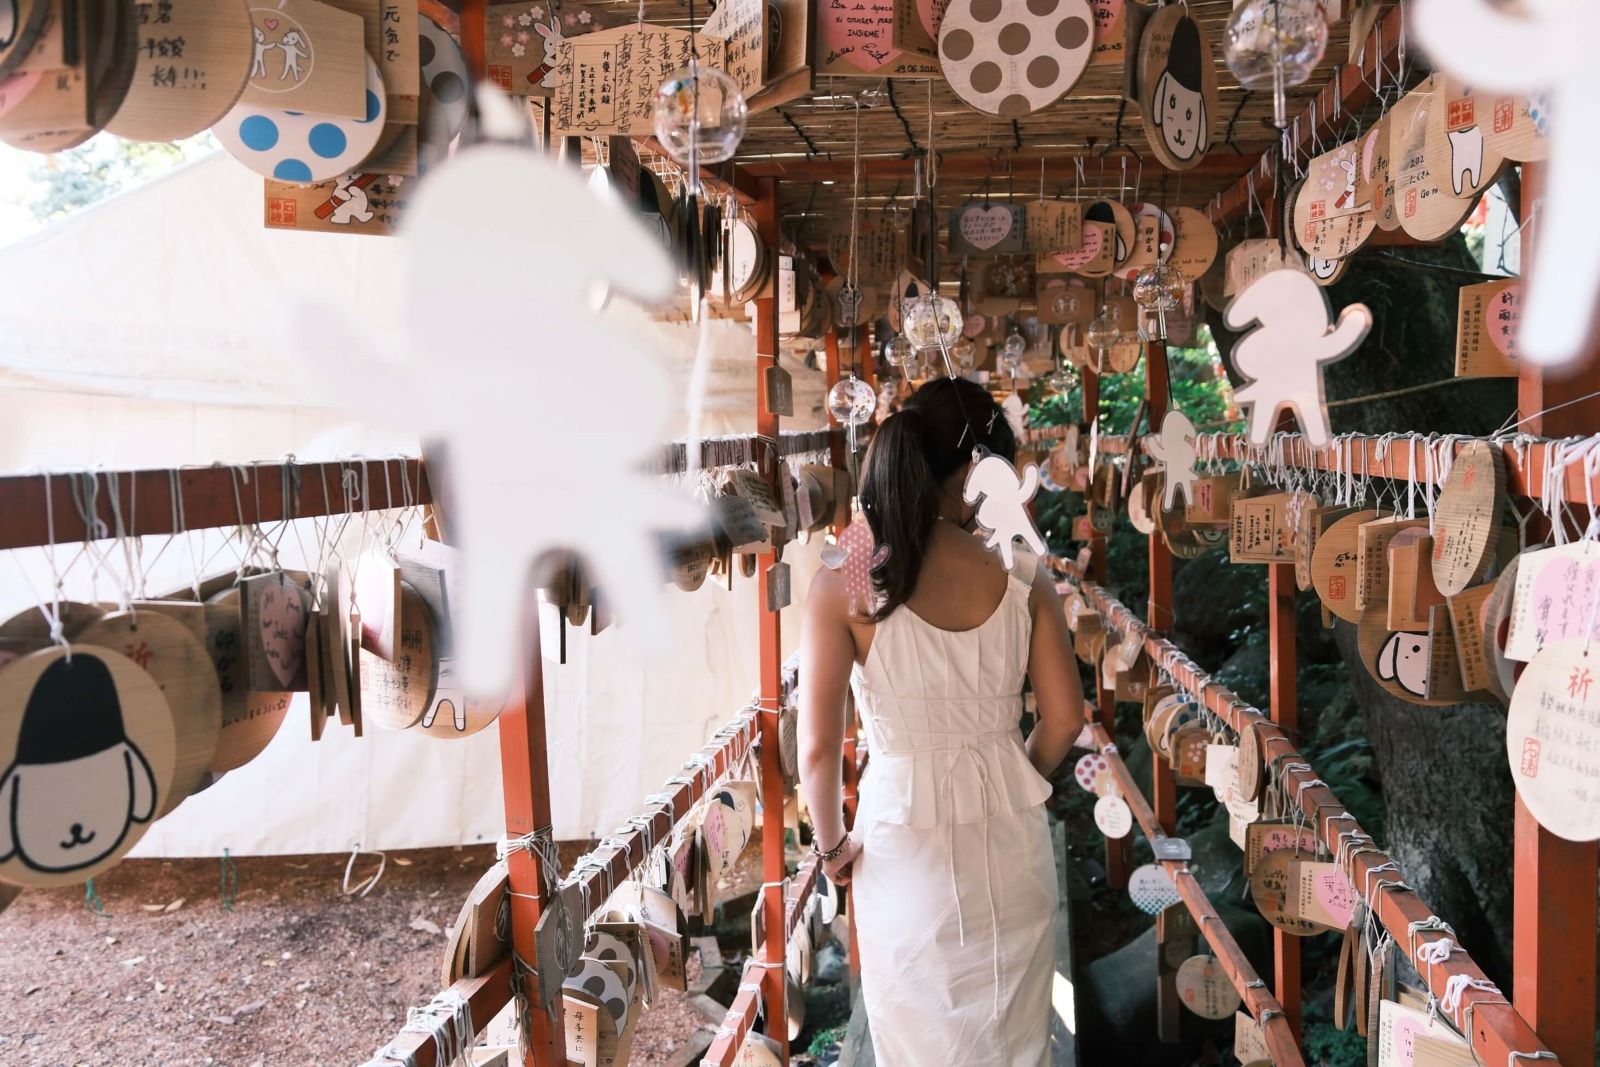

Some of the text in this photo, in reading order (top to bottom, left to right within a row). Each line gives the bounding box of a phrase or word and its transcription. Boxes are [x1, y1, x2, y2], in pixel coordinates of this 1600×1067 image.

[383, 5, 400, 63] 元気で
[1567, 666, 1594, 703] 祈
